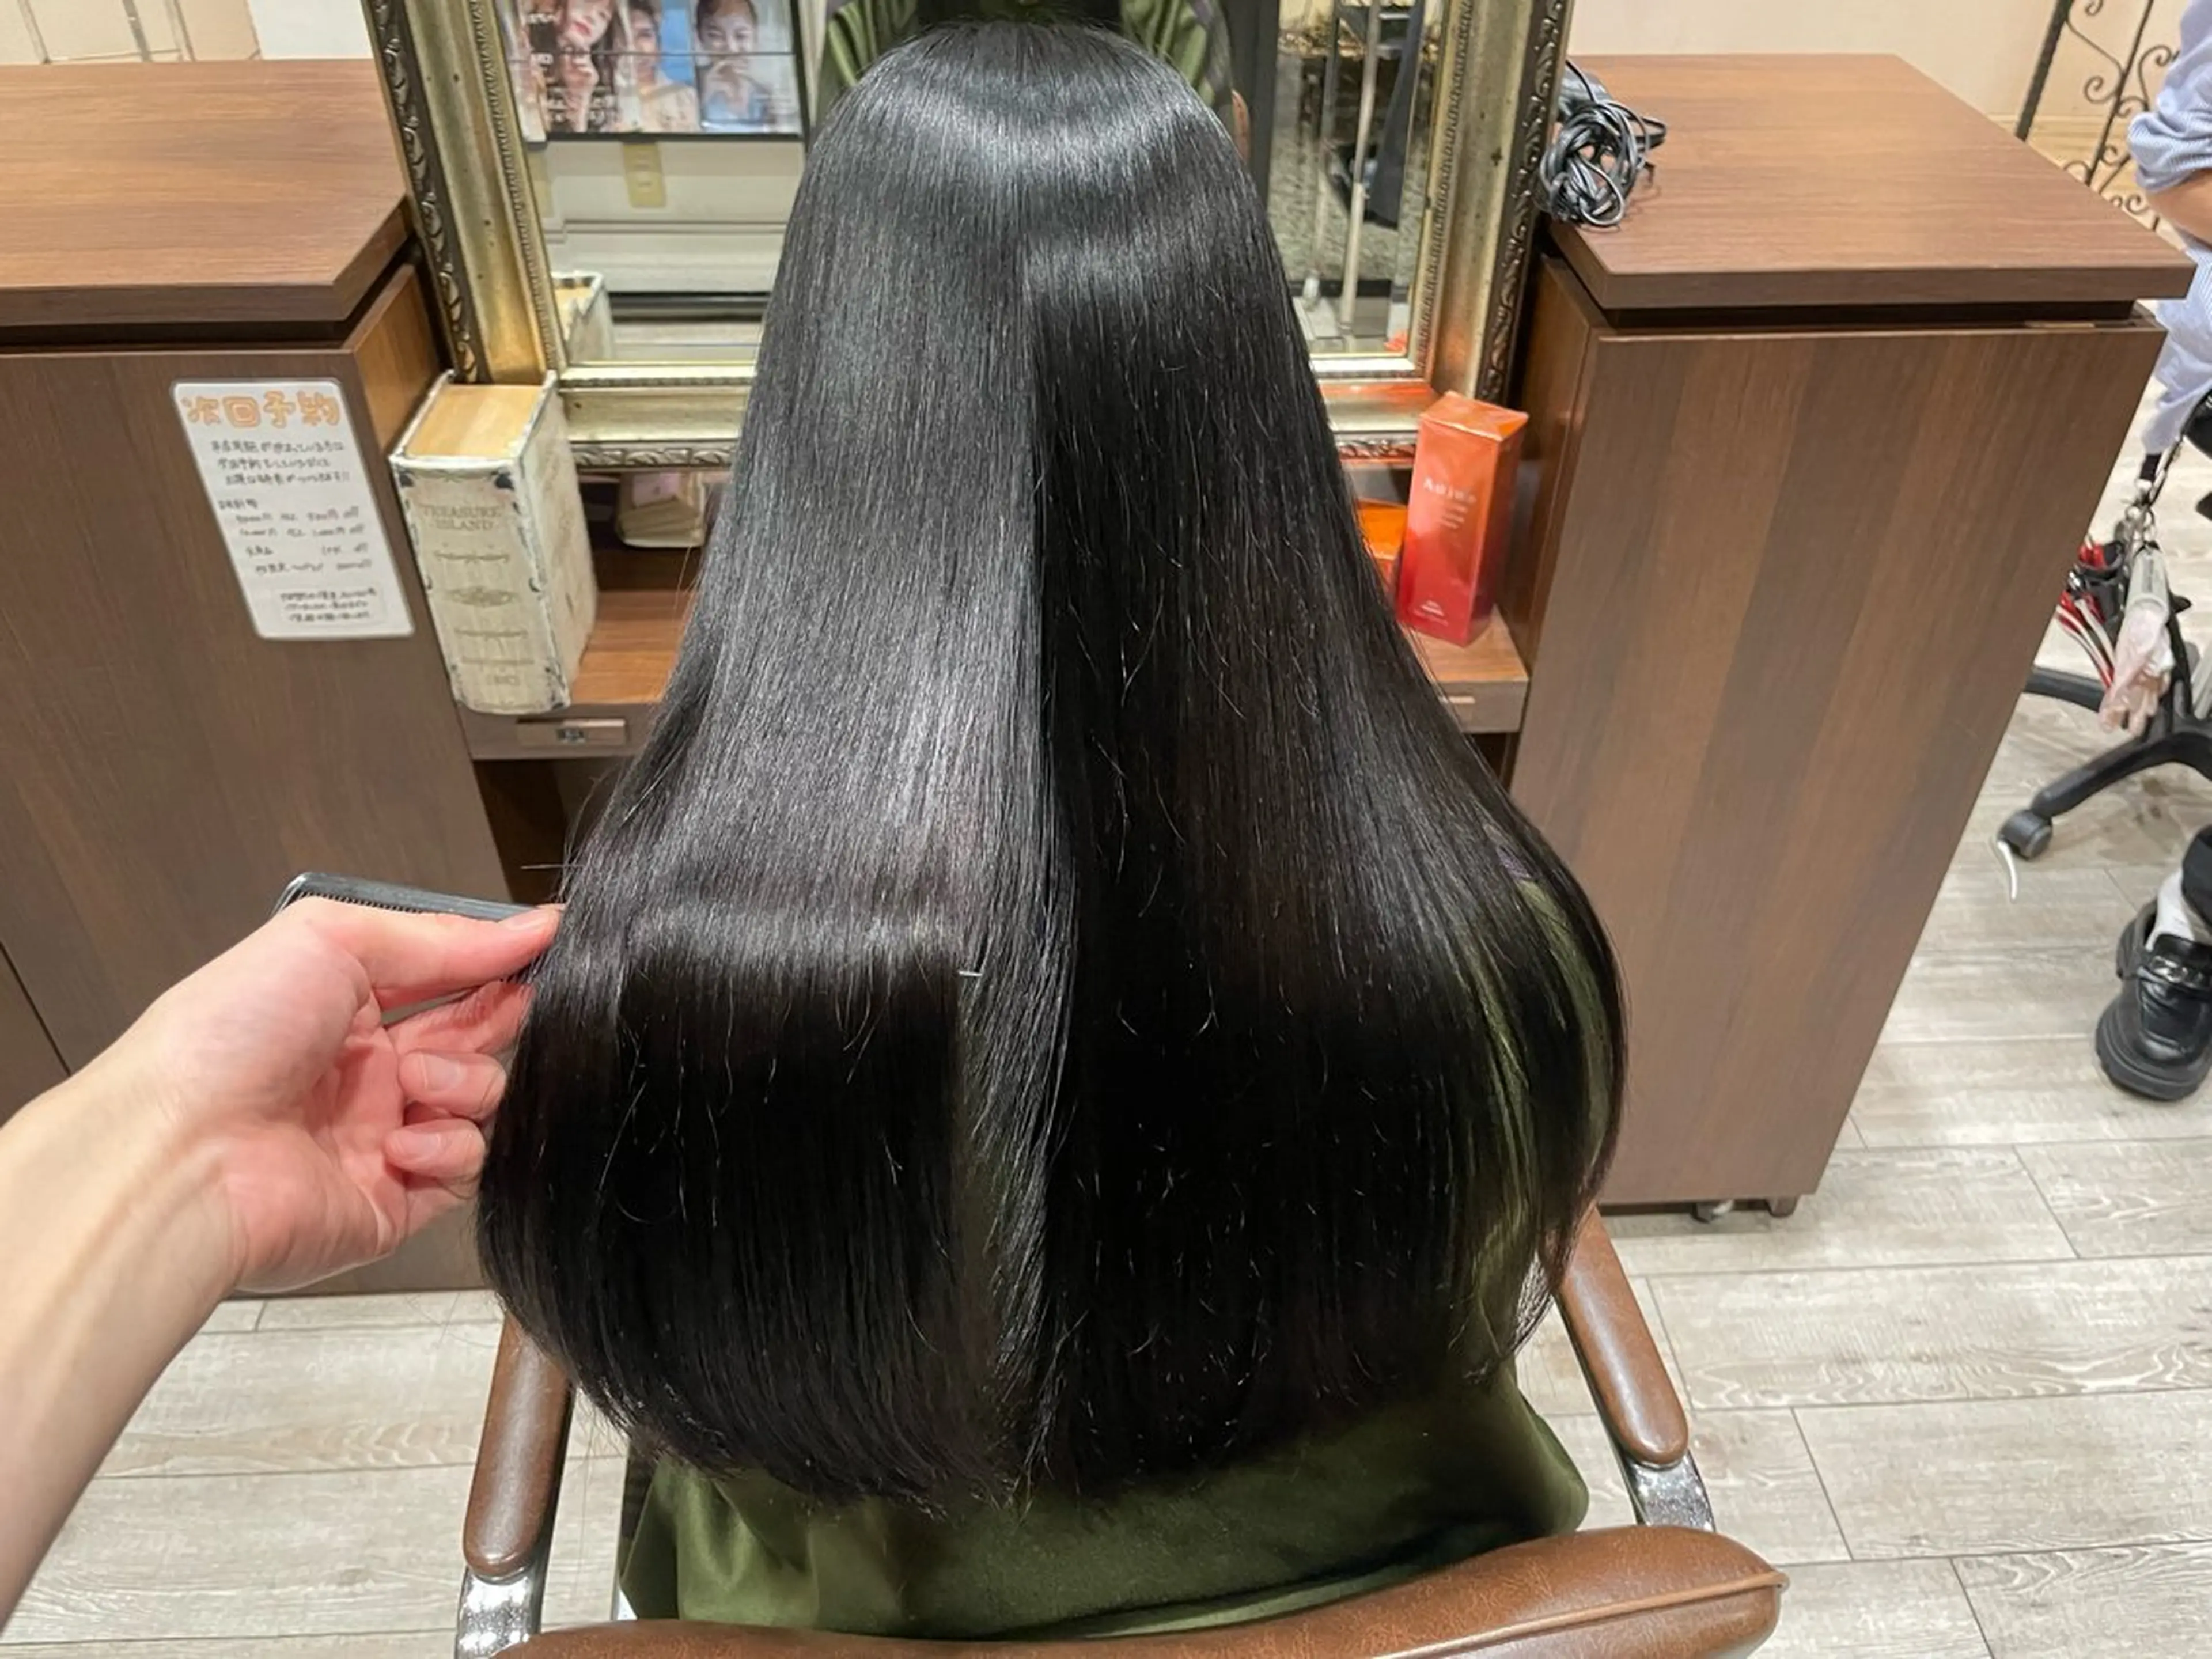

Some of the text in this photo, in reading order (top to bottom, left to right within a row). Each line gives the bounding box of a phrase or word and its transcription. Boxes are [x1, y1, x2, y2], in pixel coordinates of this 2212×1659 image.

[184, 390, 341, 429] 次回予約
[419, 503, 502, 518] TREASURE
[436, 518, 494, 531] ISLAND
